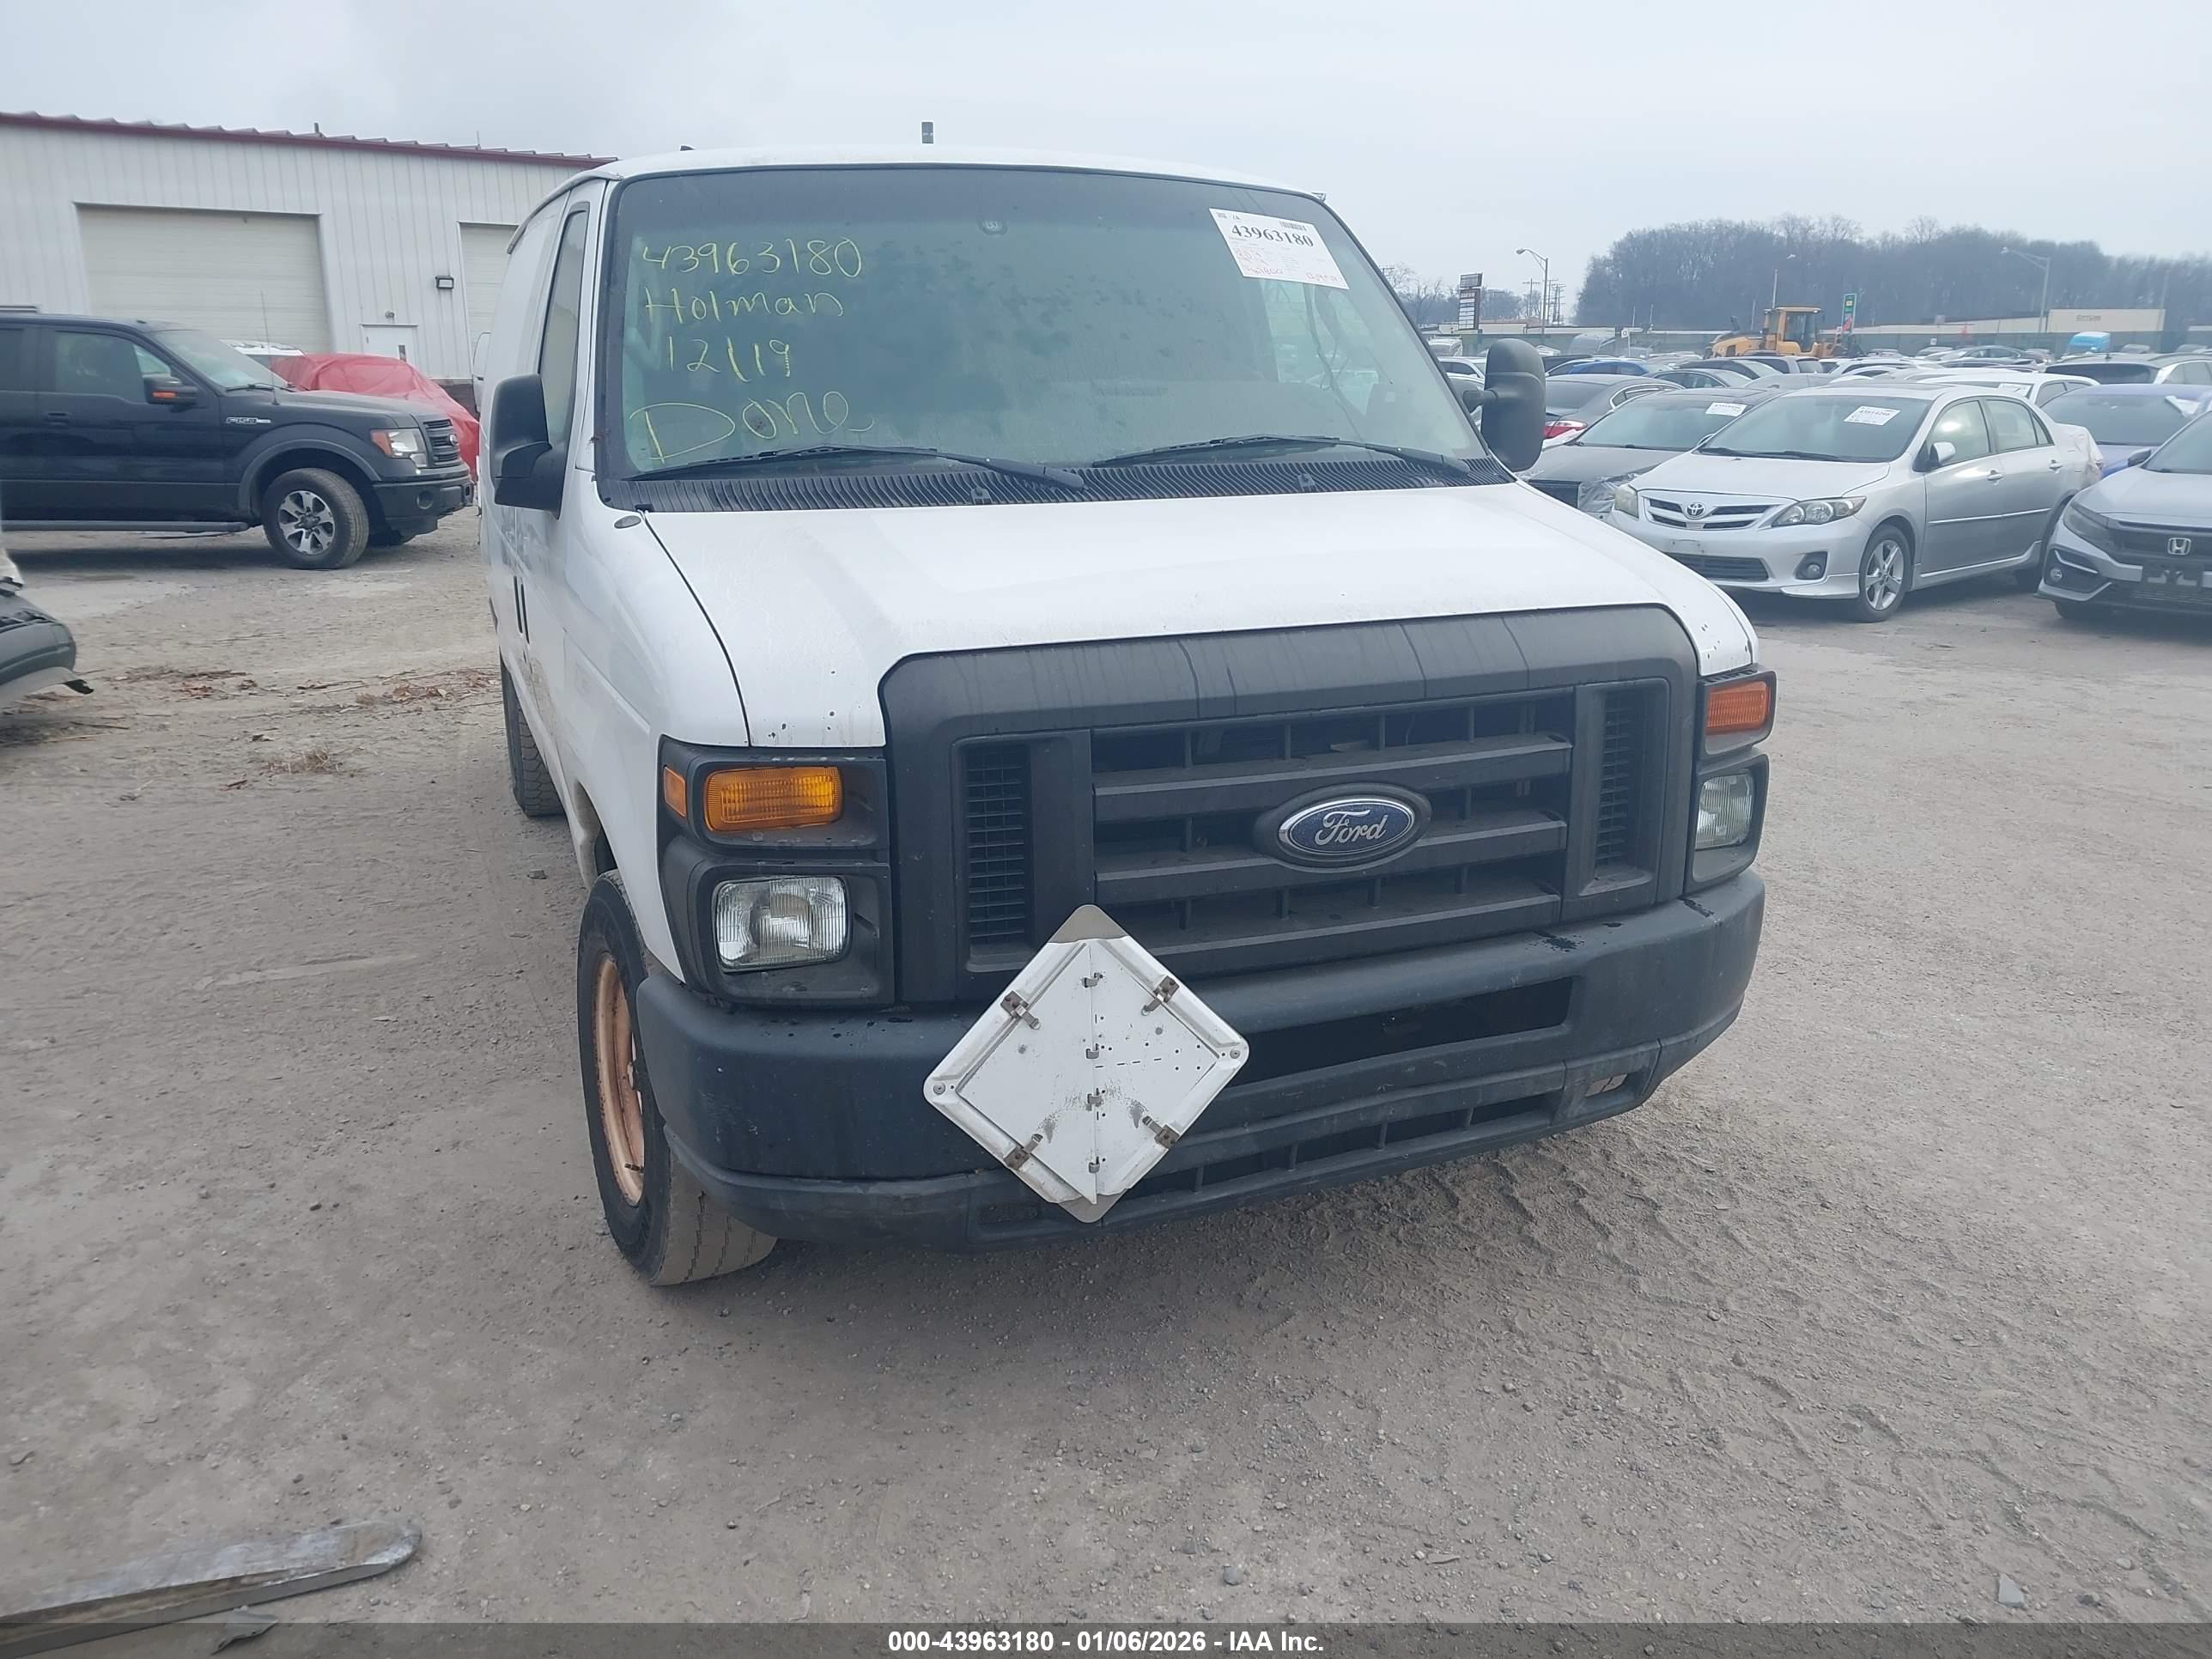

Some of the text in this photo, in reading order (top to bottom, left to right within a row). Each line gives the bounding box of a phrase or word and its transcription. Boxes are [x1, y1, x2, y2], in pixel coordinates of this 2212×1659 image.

[1231, 224, 1314, 247] 43963180
[641, 237, 862, 277] 43963180
[645, 287, 844, 324] Holman
[629, 391, 874, 464] Done
[1315, 810, 1389, 846] Ford
